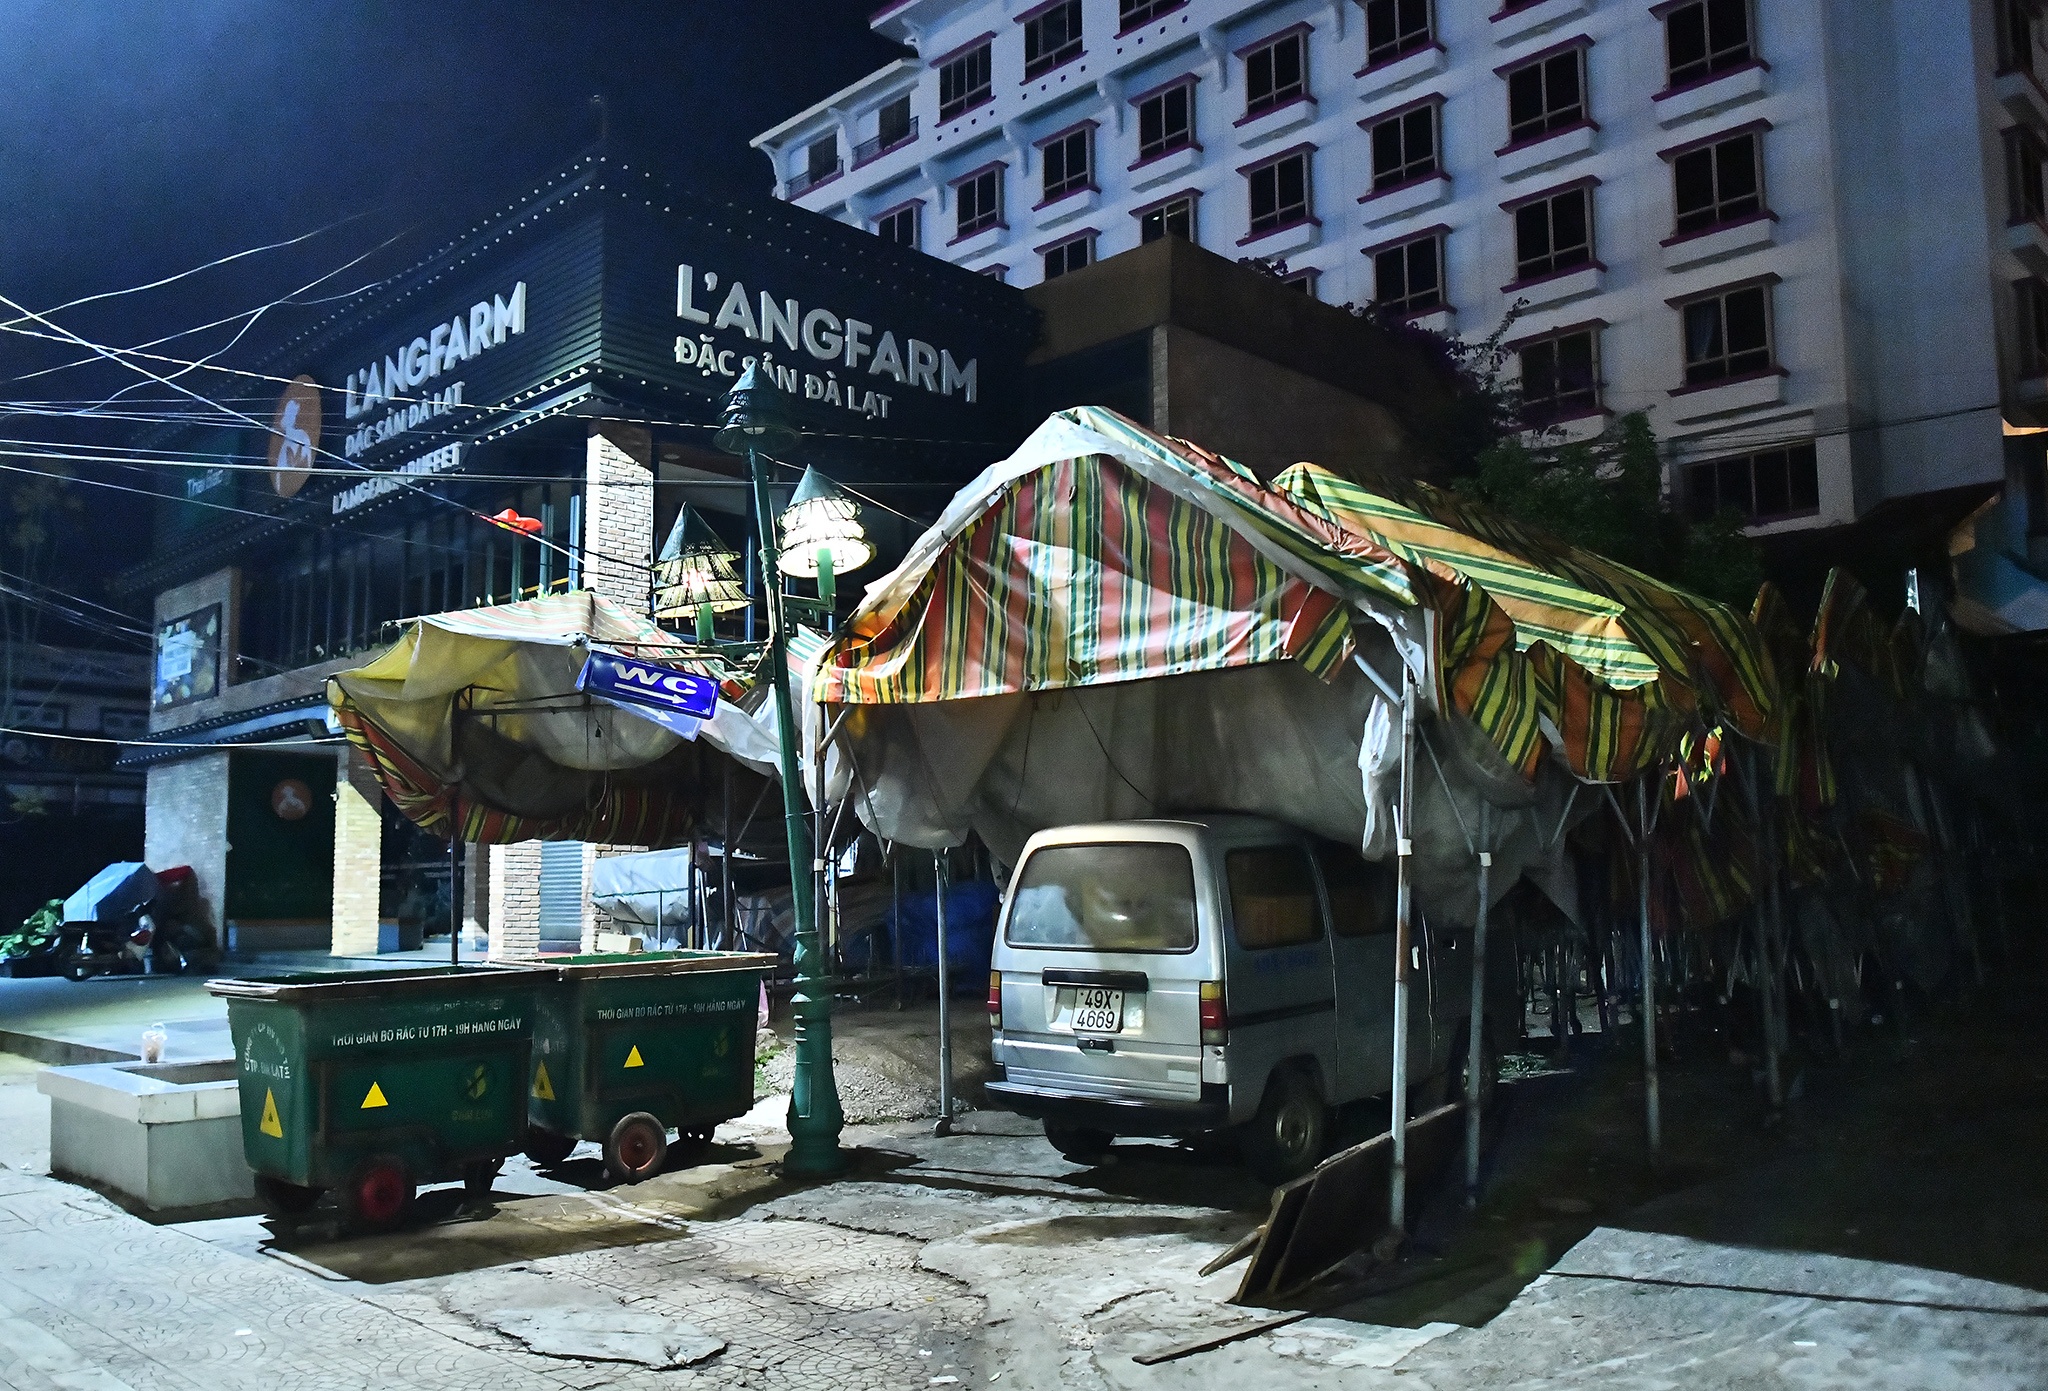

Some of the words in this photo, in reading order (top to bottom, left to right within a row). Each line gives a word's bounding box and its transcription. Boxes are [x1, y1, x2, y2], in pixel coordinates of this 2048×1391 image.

[346, 281, 526, 419] L'ANGFARM
[677, 264, 977, 403] L'ANGFARM
[674, 333, 736, 377] ĐẶC
[805, 371, 842, 407] ĐÀ
[847, 386, 893, 420] LẠT
[612, 661, 698, 695] WC
[1085, 990, 1113, 1010] 49X
[432, 1025, 447, 1038] 17H
[455, 1022, 471, 1035] 19H
[1077, 1010, 1115, 1029] 4669
